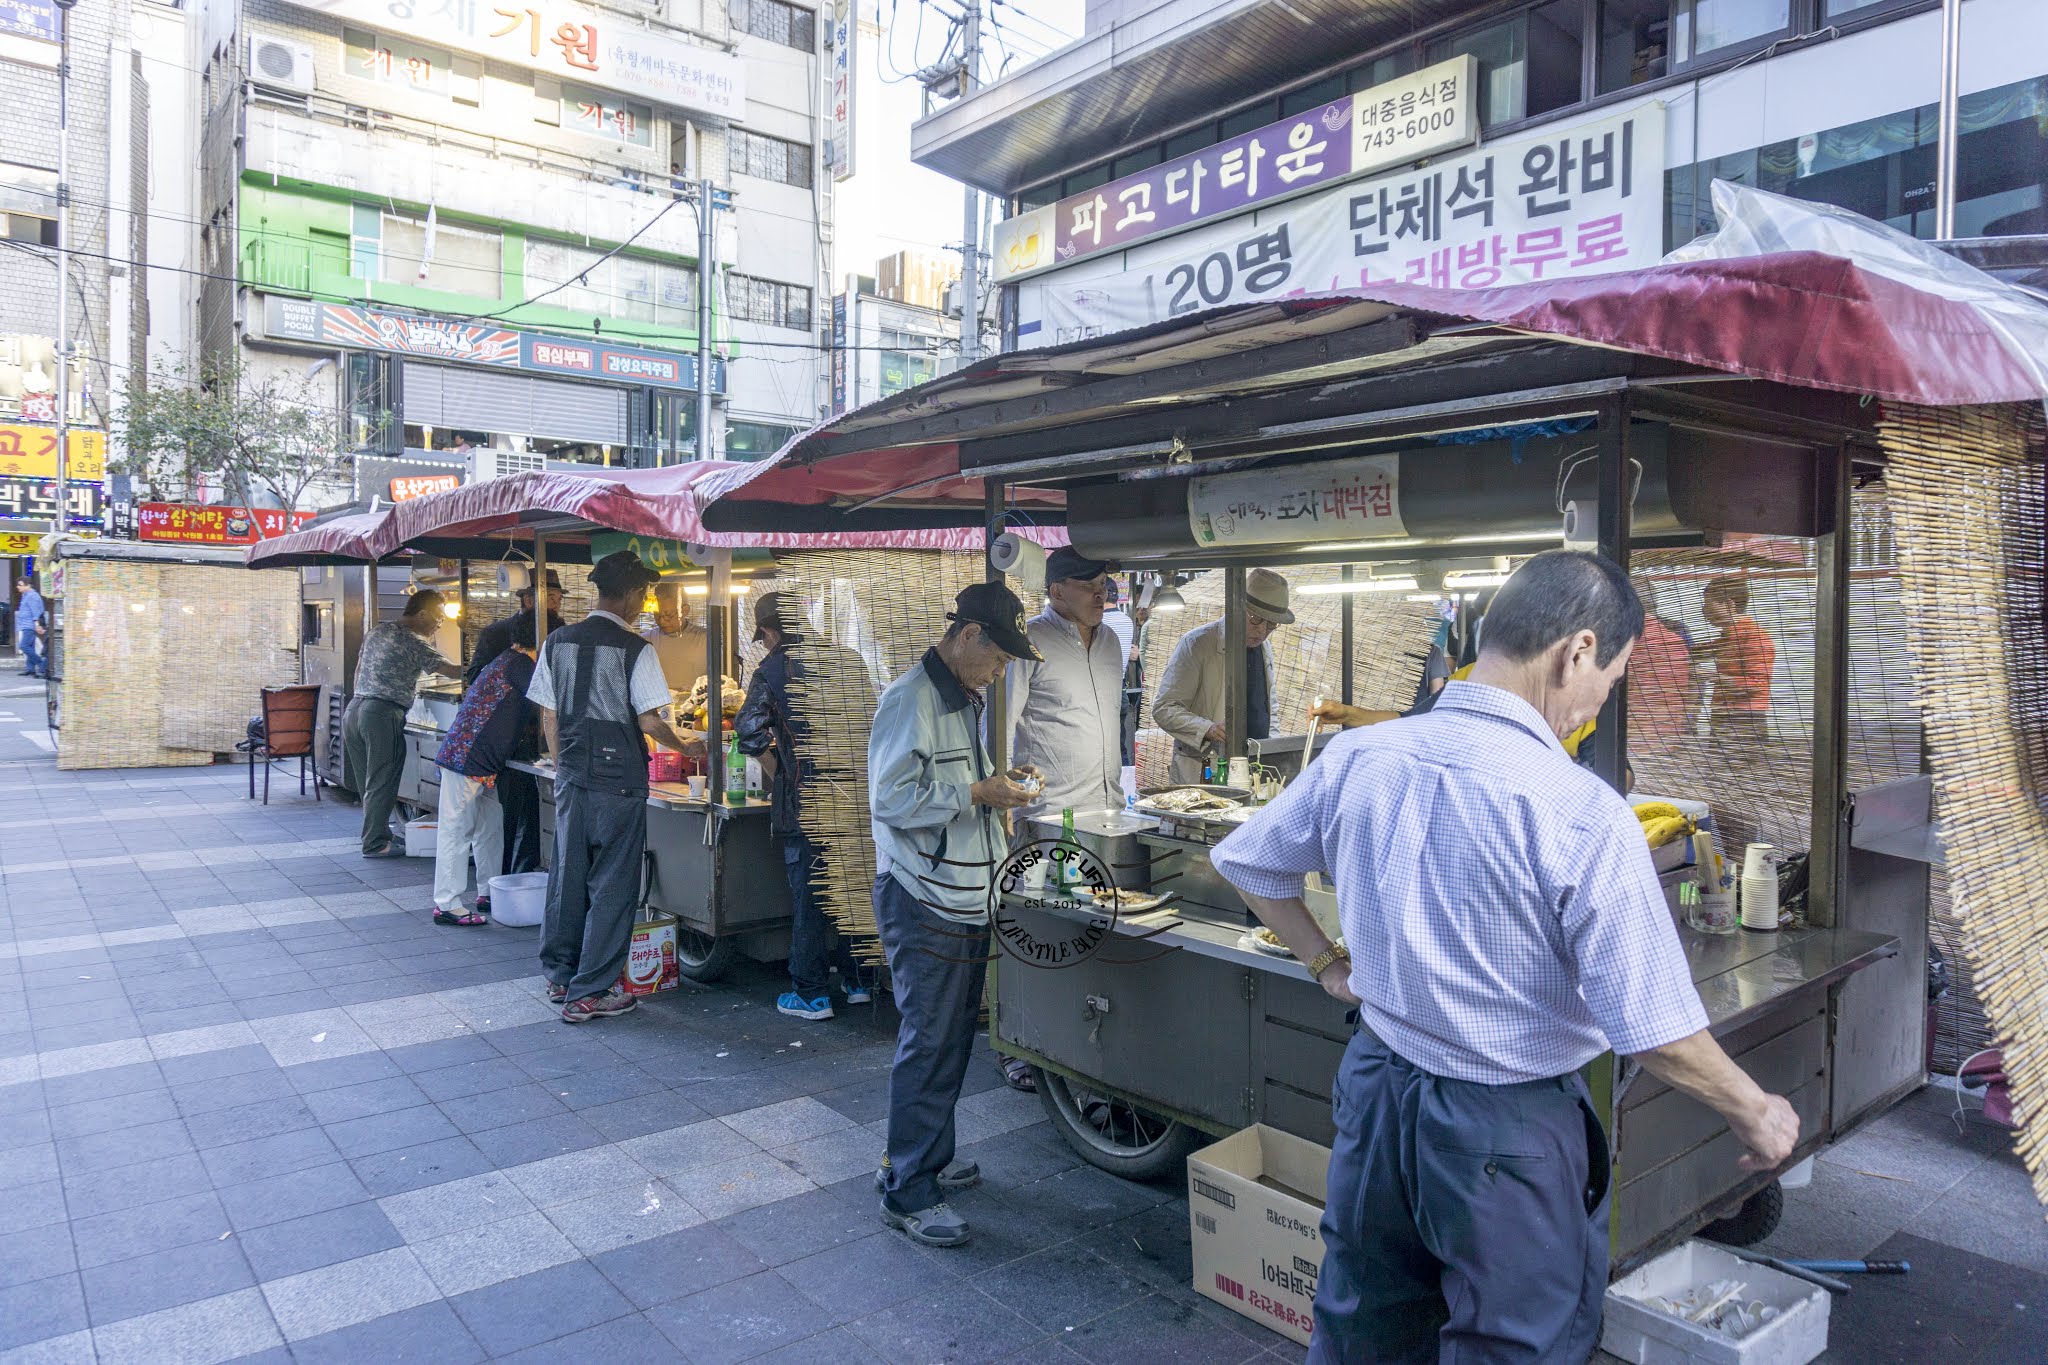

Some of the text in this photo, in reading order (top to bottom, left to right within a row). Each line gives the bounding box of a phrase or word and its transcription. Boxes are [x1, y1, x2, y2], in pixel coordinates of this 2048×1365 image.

[1362, 76, 1458, 127] 대중음식점
[1363, 106, 1456, 153] 743-6000
[1070, 122, 1328, 244] 파고다타운
[1349, 156, 1496, 257] 단체석
[1518, 119, 1633, 219] 완비
[283, 303, 316, 315] DOUBLE
[284, 313, 315, 324] BUFFET
[284, 321, 315, 332] POCHA
[1323, 482, 1393, 520] 대박집
[632, 948, 661, 961] 태양초
[1248, 1289, 1314, 1333] G생활건강
